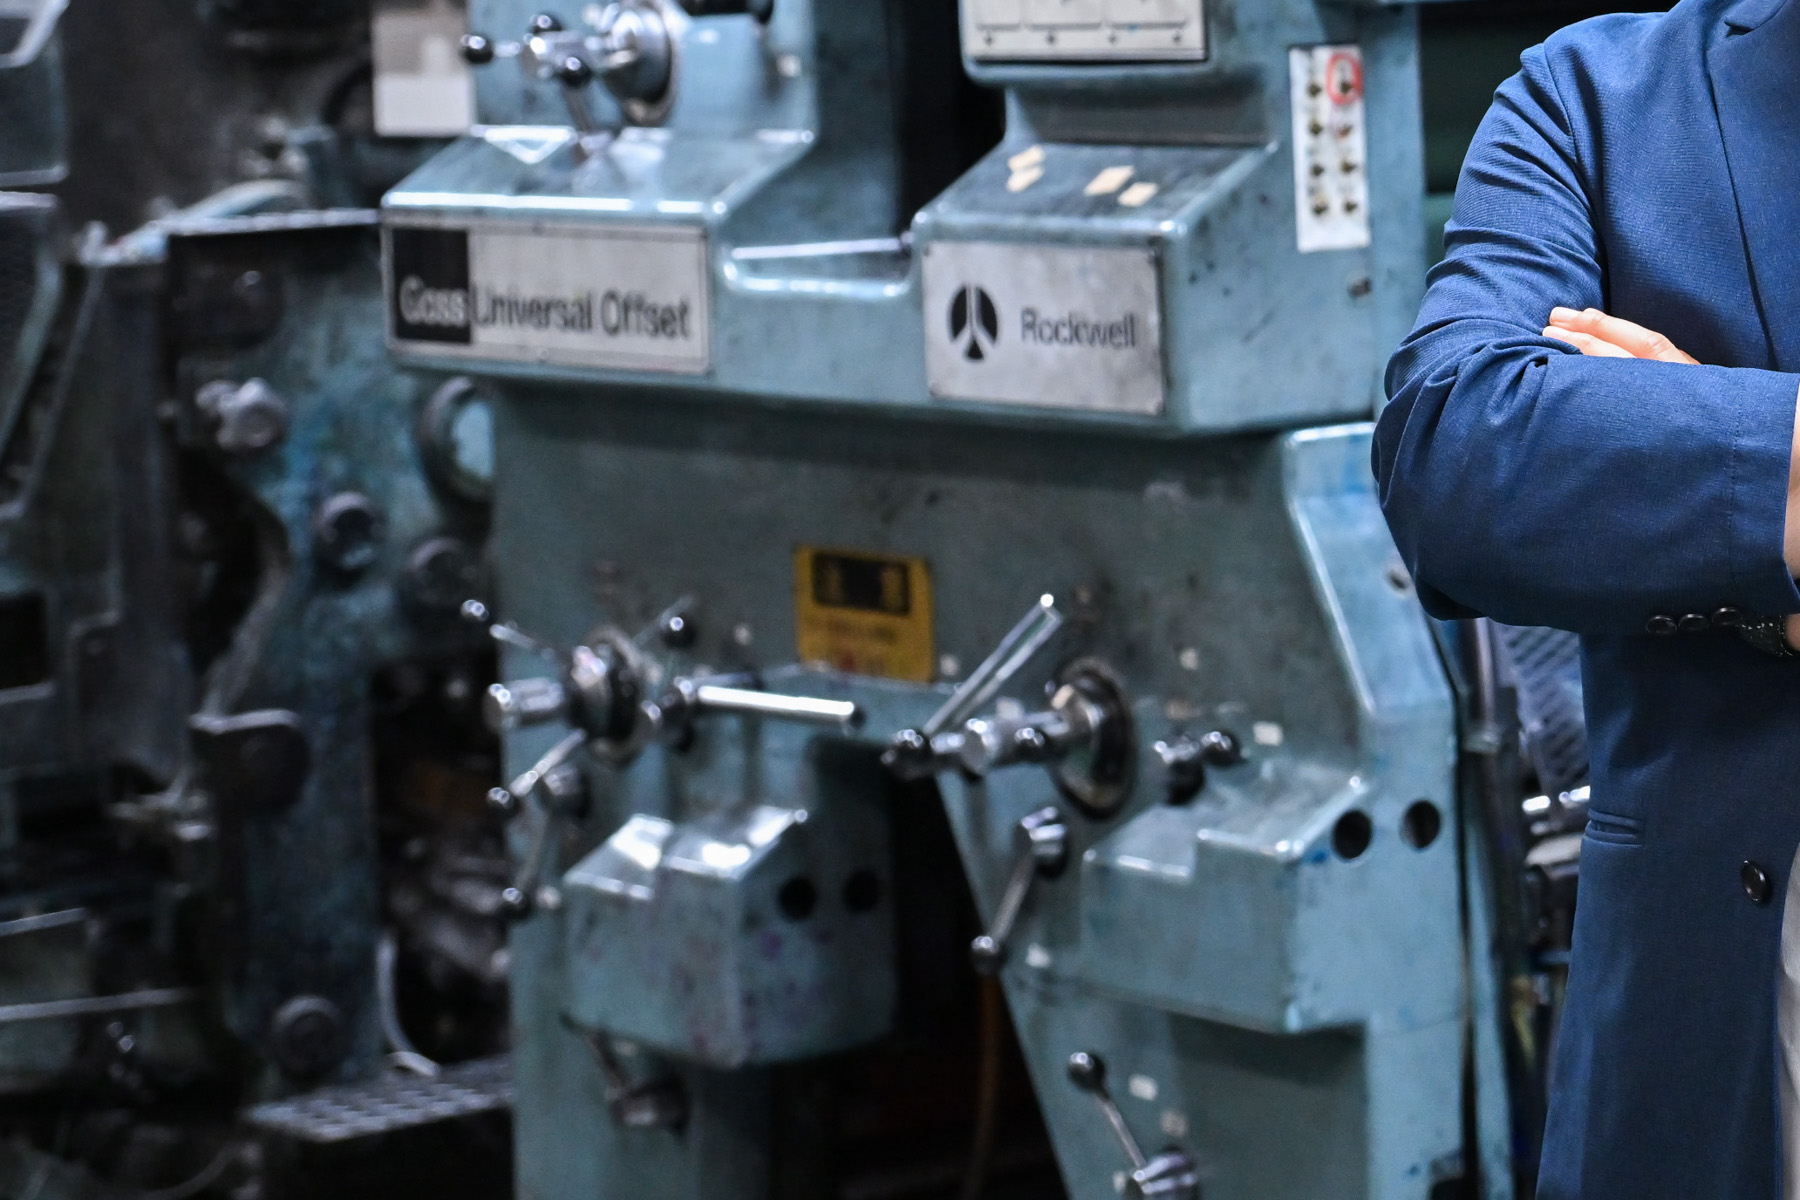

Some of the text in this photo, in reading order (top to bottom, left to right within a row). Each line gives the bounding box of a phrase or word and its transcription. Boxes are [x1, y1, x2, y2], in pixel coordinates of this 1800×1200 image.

[472, 283, 593, 332] Universal
[600, 289, 690, 339] Offset
[1021, 308, 1137, 348] Rockwell
